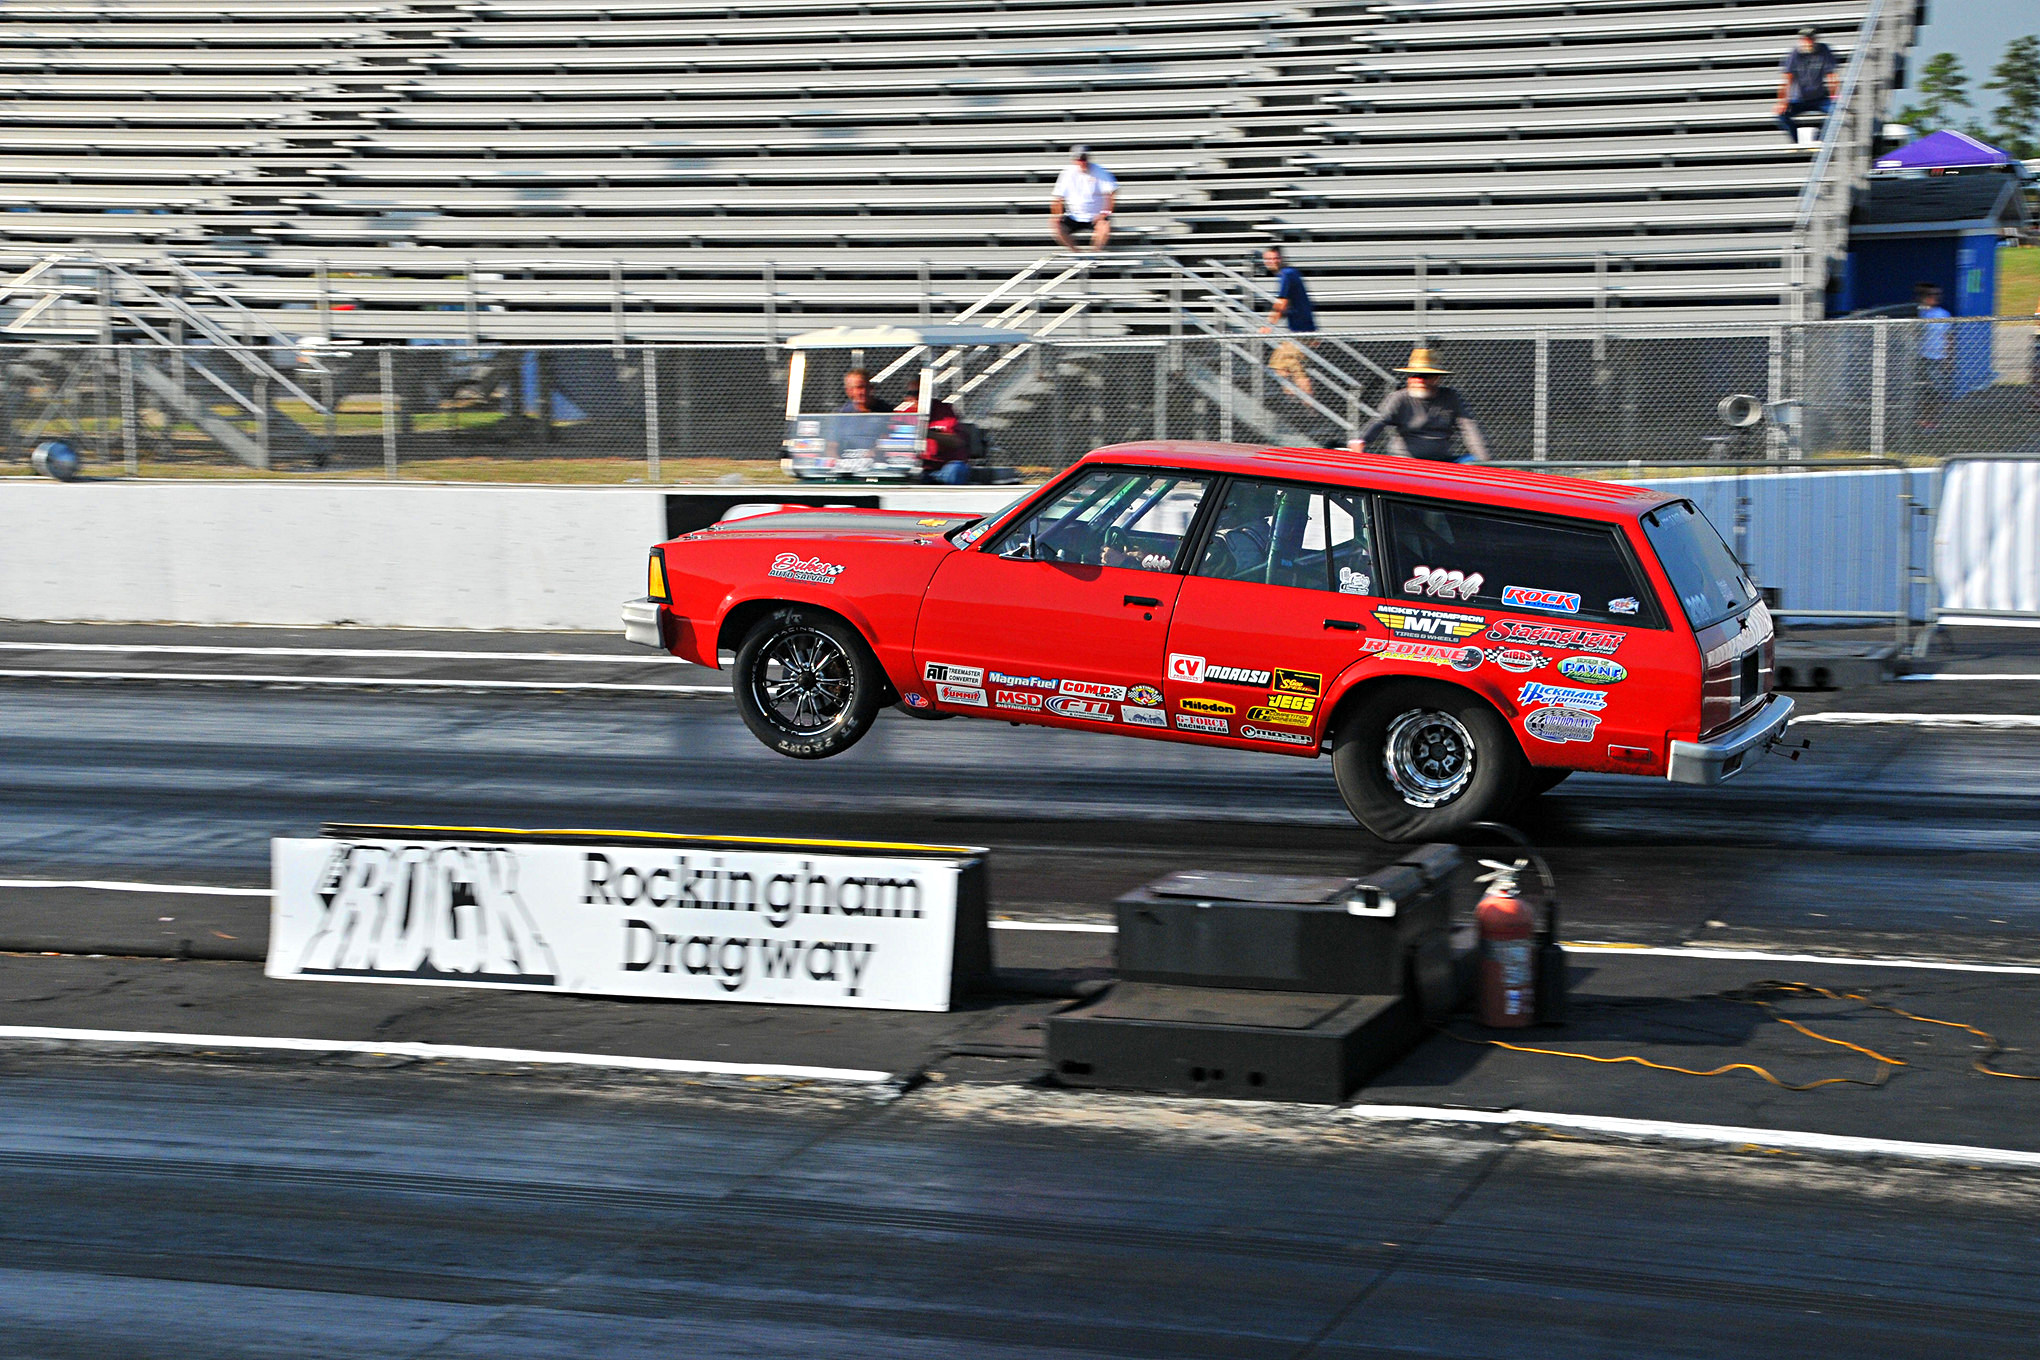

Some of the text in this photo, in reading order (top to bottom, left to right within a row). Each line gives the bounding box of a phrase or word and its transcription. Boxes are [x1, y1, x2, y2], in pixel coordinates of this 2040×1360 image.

[772, 553, 831, 575] Dukes
[769, 570, 794, 579] AUTO
[795, 573, 836, 584] SALVAGE
[1404, 565, 1484, 600] 2924
[1505, 588, 1578, 610] ROCK
[1377, 605, 1484, 623] MICKEY THOMPSON
[1403, 616, 1460, 635] M/T
[1395, 630, 1419, 639] TIRES
[1426, 634, 1460, 643] WHEELS
[1365, 640, 1468, 661] REDLINE
[1502, 650, 1532, 661] GIBBS
[949, 667, 981, 677] TREEMASTER
[1174, 659, 1200, 676] CV
[1204, 665, 1271, 684] MOROSO
[1562, 661, 1622, 678] PAYNE
[949, 675, 979, 684] CONVERTER
[989, 672, 1057, 689] MagnaFuel
[1063, 681, 1111, 695] COMP
[905, 693, 920, 706] VP
[998, 691, 1041, 706] MSD
[1060, 699, 1108, 714] FTI
[1182, 700, 1234, 714] Milodon
[1268, 694, 1316, 712] JEGS
[1176, 715, 1227, 727] G-FORCE
[1178, 722, 1228, 733] RACING GEAR
[580, 853, 925, 927] Rockingham
[299, 845, 556, 974] ROCK
[624, 919, 877, 997] Dragway
